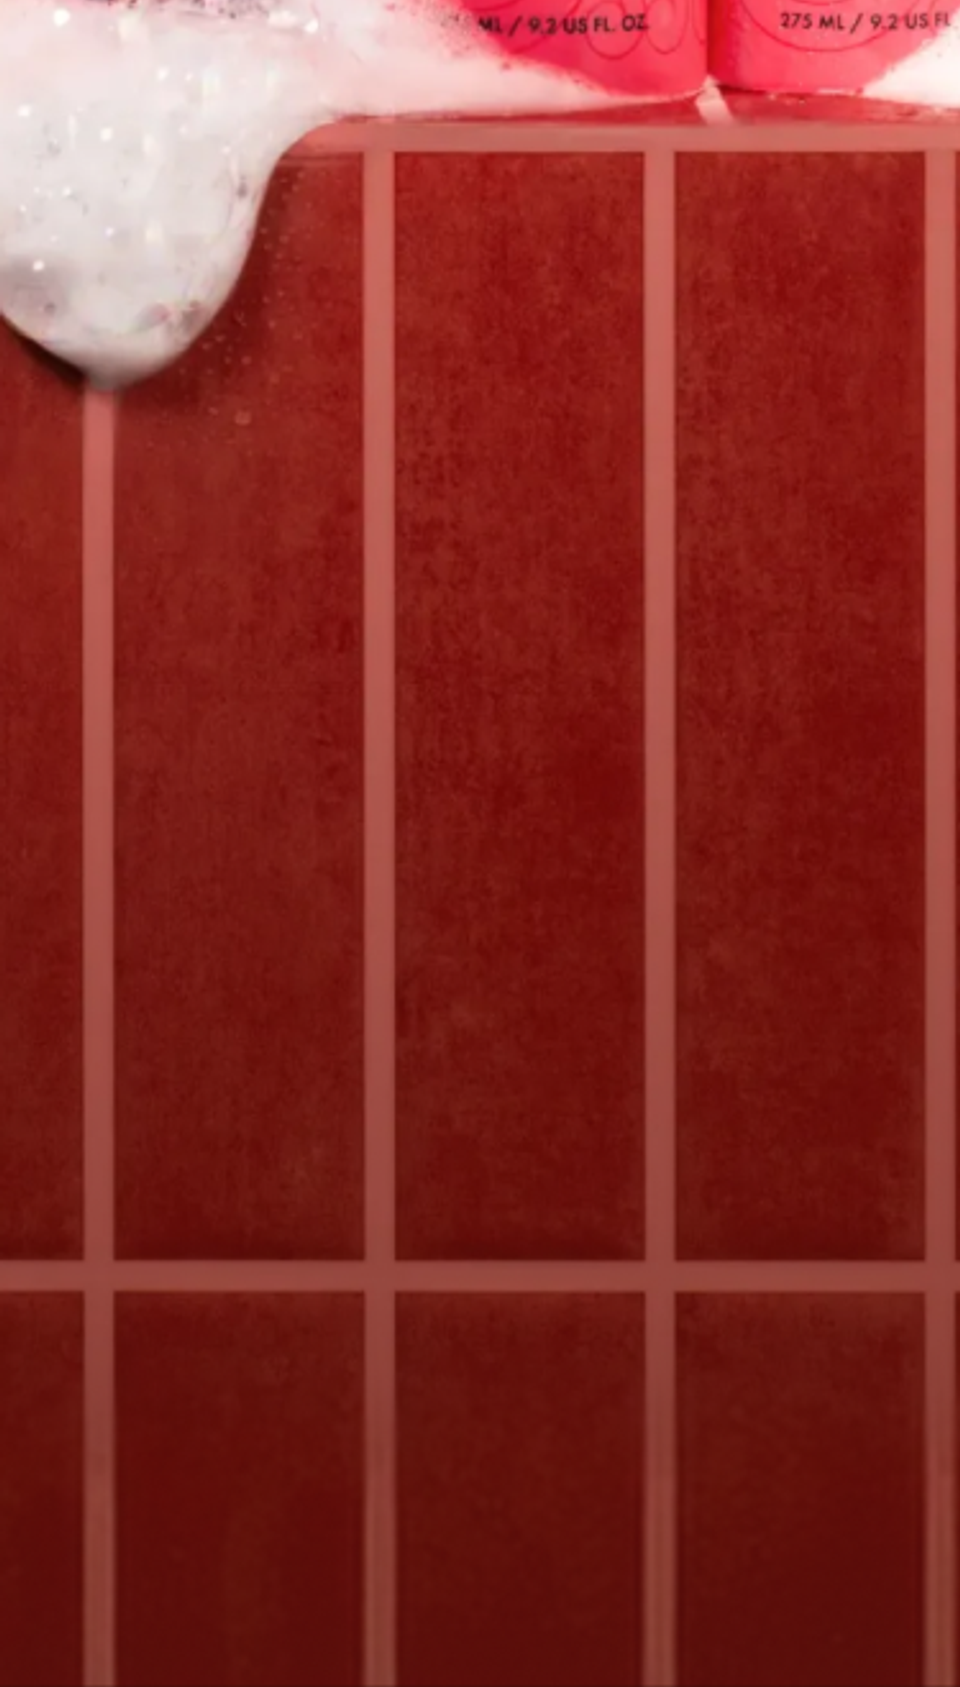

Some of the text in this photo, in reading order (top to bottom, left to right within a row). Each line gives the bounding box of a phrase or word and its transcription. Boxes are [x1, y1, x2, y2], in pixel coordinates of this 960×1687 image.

[506, 15, 524, 38] /
[526, 15, 558, 36] 9.2
[560, 16, 589, 35] US
[780, 11, 813, 30] 275
[818, 14, 845, 31] ML
[849, 12, 864, 35] /
[869, 13, 899, 31] 9.2
[903, 12, 930, 31] US
